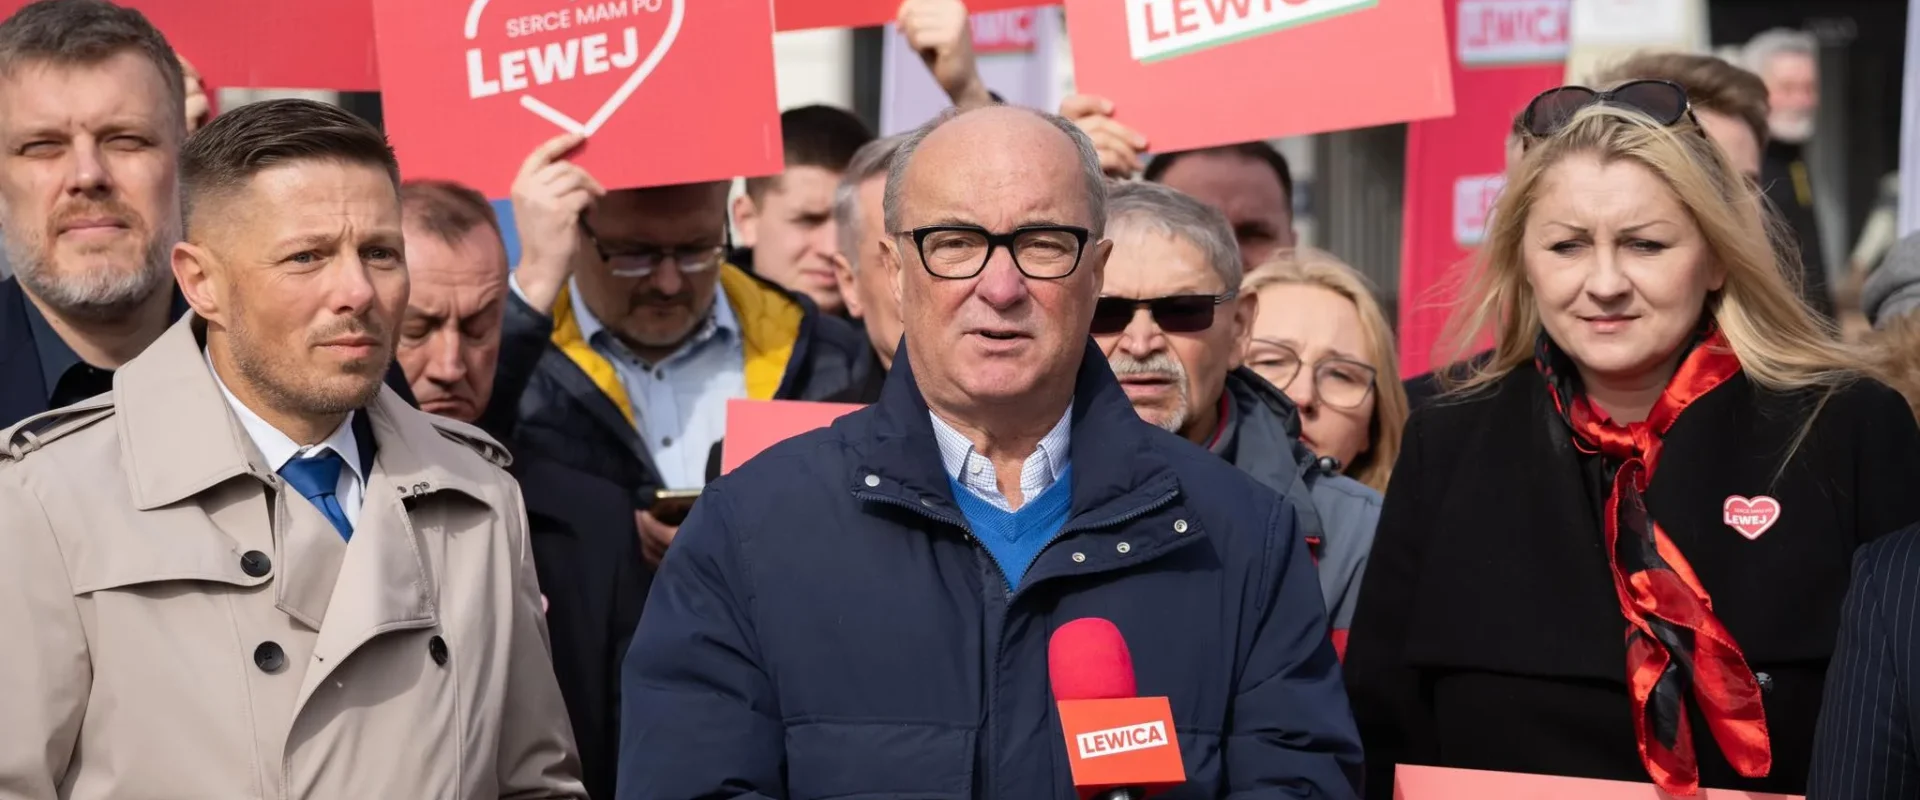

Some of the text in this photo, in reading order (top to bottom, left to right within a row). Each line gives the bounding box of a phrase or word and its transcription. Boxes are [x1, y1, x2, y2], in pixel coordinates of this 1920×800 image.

[505, 0, 662, 38] SERCE MAM PO
[466, 27, 640, 100] LEWEJ
[1725, 511, 1767, 525] LEWEJ
[1083, 725, 1162, 754] LEWICA
